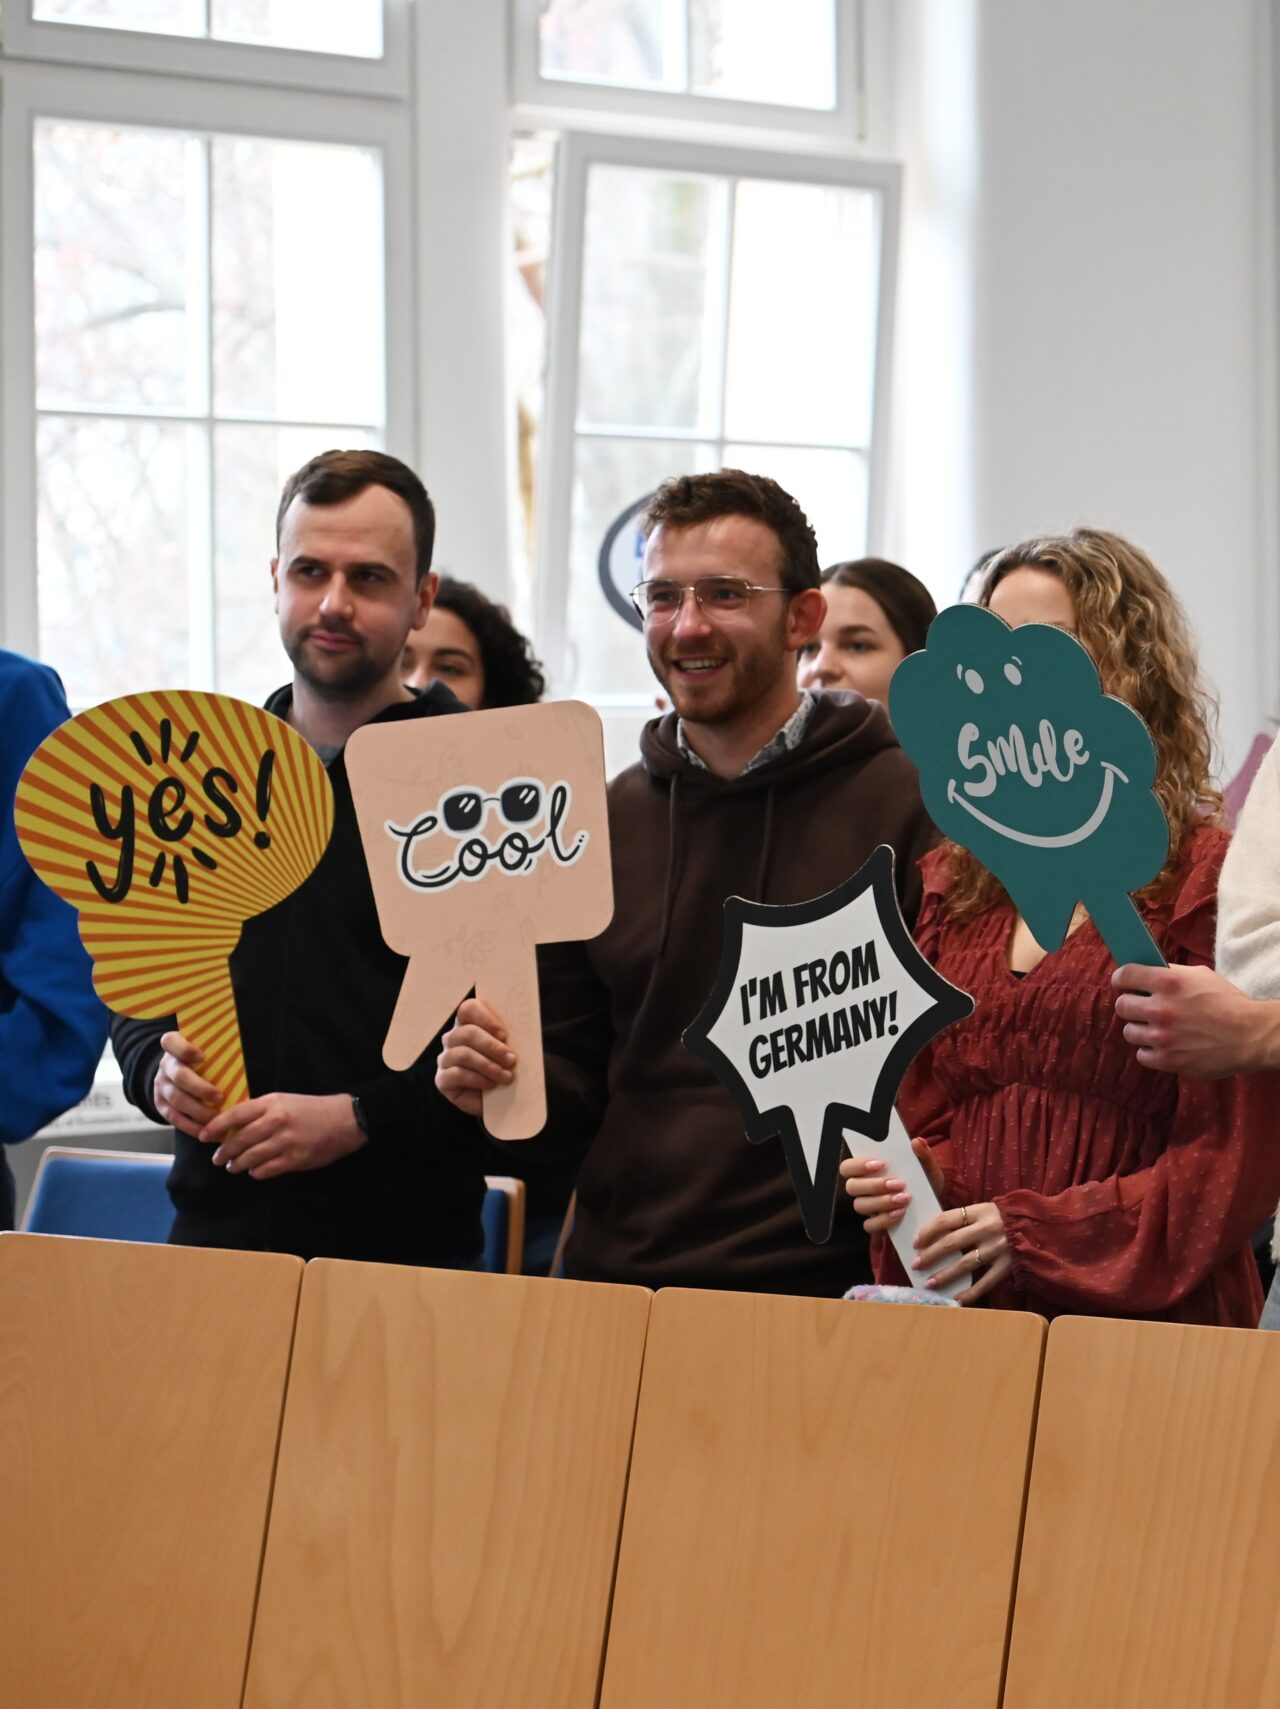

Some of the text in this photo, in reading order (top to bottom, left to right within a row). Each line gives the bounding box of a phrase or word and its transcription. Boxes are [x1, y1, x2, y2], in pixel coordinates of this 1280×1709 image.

[957, 718, 1091, 798] Smile
[86, 748, 276, 903] yes!
[388, 783, 585, 888] Cool
[740, 939, 880, 1026] I'M FROM
[748, 990, 899, 1079] GERMANY!
